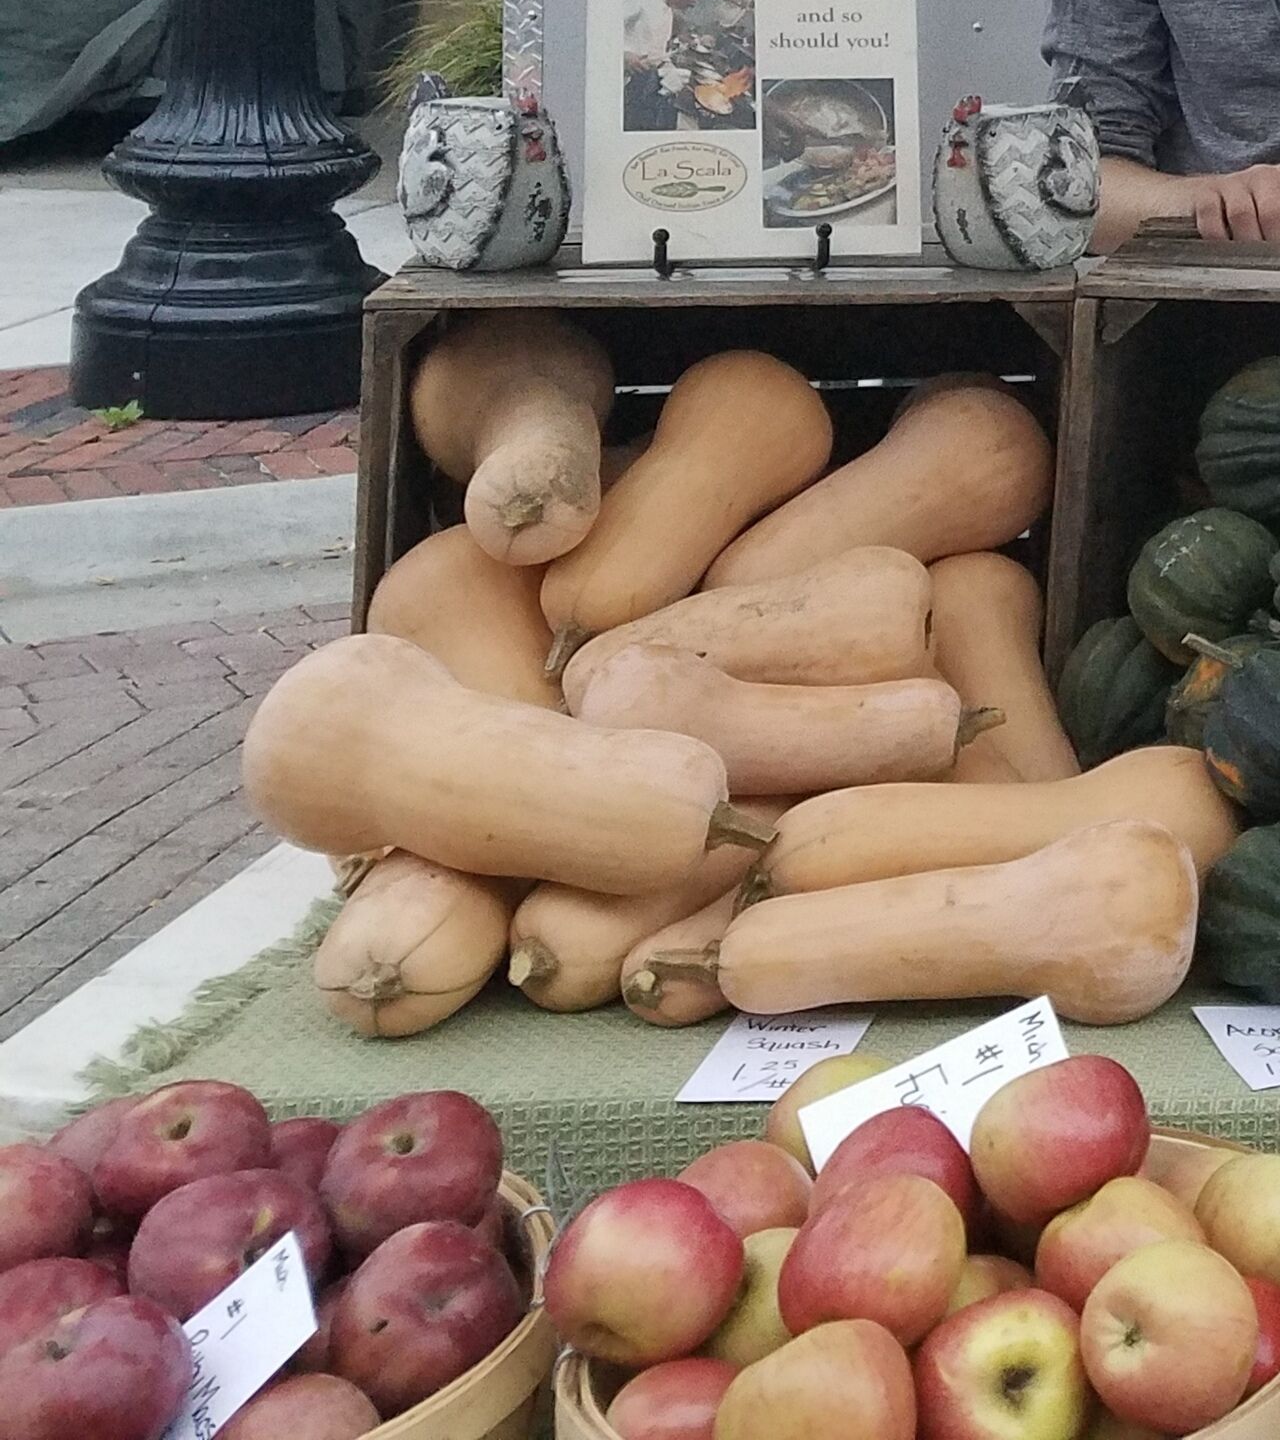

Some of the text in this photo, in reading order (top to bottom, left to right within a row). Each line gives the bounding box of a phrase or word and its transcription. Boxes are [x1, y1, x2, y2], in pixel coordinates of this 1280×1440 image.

[797, 7, 863, 24] and so
[769, 32, 890, 52] should you!
[642, 160, 732, 180] La Scala
[747, 1017, 826, 1035] Winter
[746, 1038, 840, 1053] Squash
[1019, 1010, 1051, 1064] Mich
